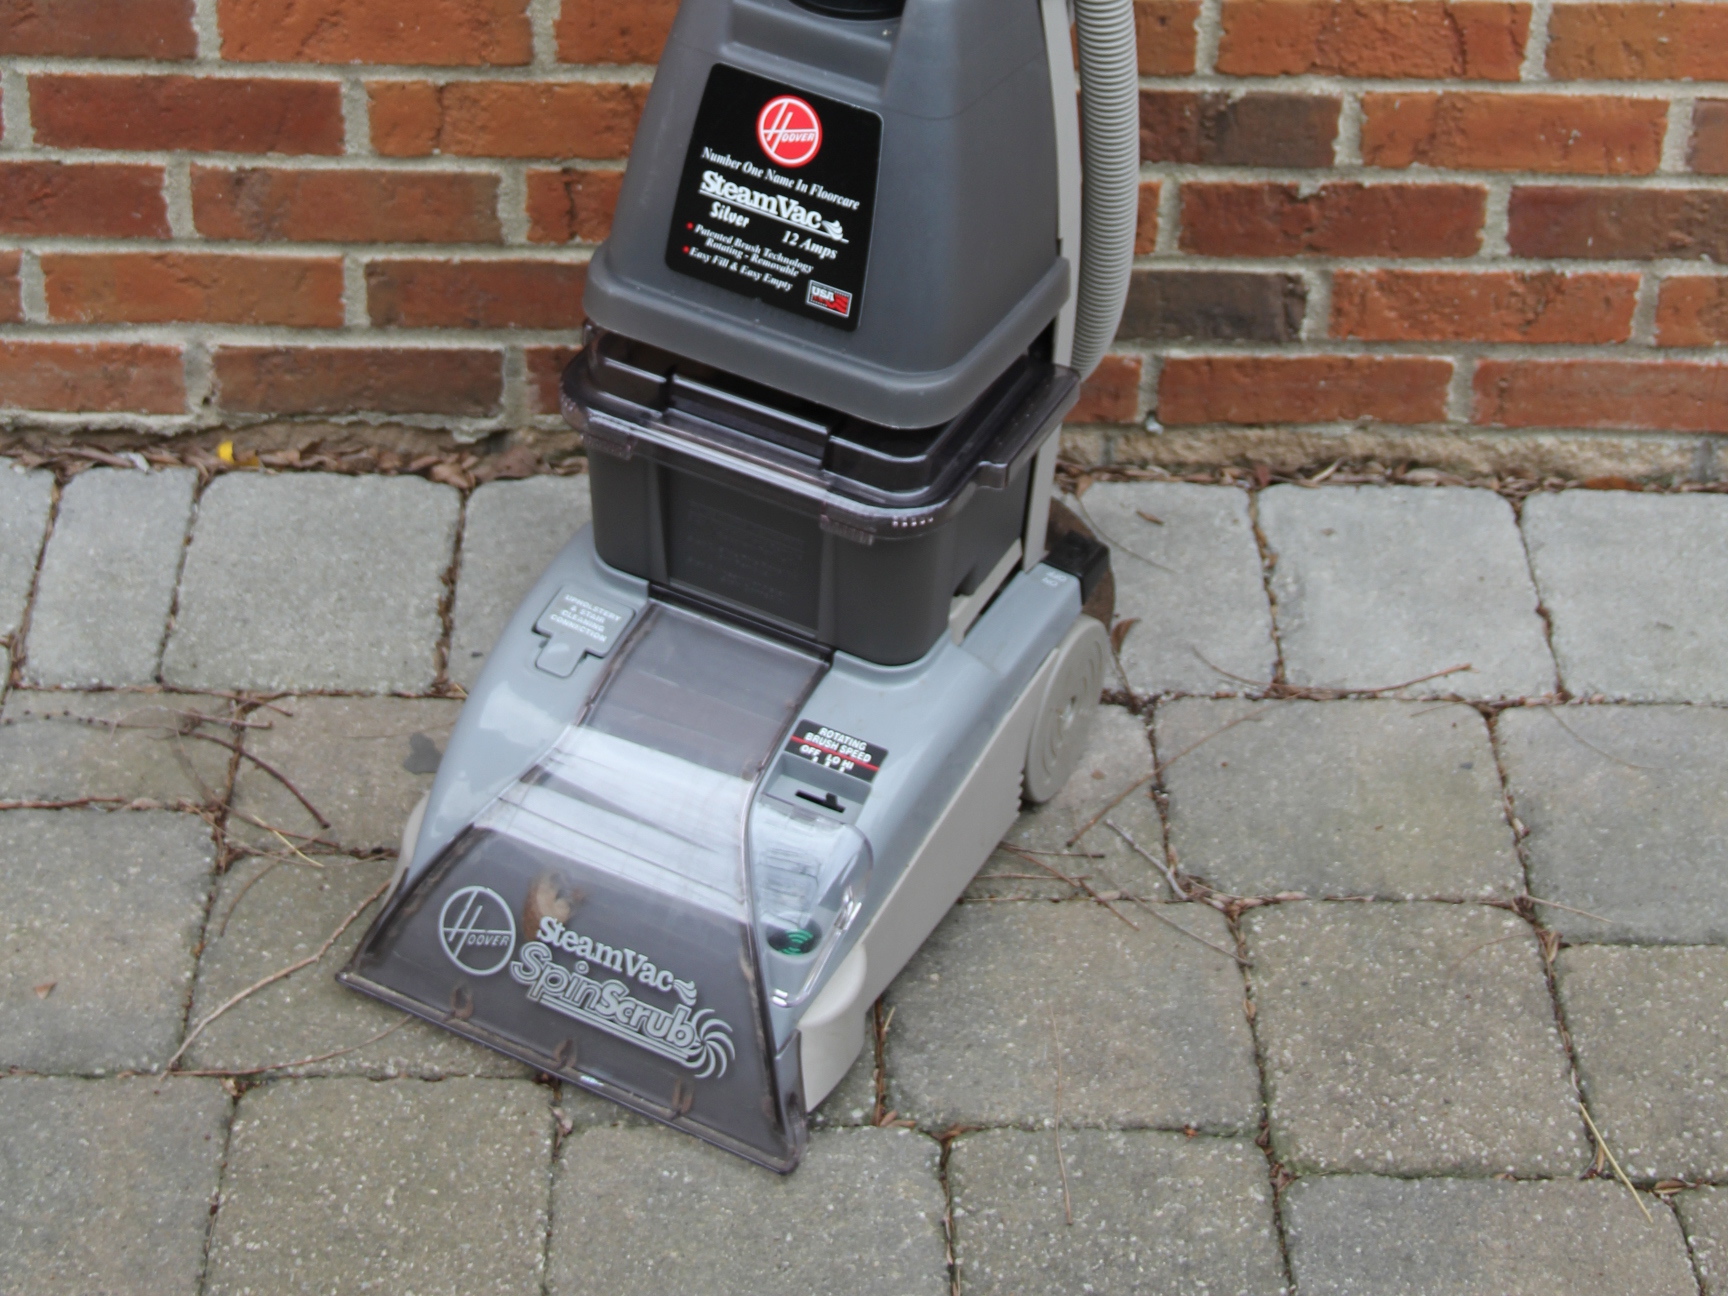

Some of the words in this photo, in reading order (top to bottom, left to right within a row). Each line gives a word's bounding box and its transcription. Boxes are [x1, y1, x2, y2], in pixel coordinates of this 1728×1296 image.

[763, 101, 817, 154] HOOVER
[701, 146, 742, 170] Number
[742, 161, 764, 178] One
[765, 168, 795, 189] Name
[795, 179, 808, 193] In
[809, 183, 860, 211] Floorcare
[700, 170, 823, 229] SteamVac
[709, 201, 750, 228] Silver
[694, 223, 733, 245] Patented
[733, 236, 761, 254] Brush
[762, 247, 814, 274] Technology
[705, 237, 744, 260] Rotating
[750, 253, 799, 278] Removable
[781, 230, 800, 246] 12
[799, 238, 838, 260] Amps
[689, 246, 711, 263] Easy
[711, 254, 728, 268] Fill
[728, 261, 738, 272] &
[739, 264, 762, 282] Easy
[762, 272, 794, 292] Empty
[811, 285, 835, 303] USA
[561, 609, 605, 633] CLEANING
[564, 594, 622, 622] UPHOLSTERY
[579, 608, 606, 624] STAIR
[799, 744, 822, 756] OFF
[826, 754, 841, 765] LO
[841, 759, 854, 770] HI
[805, 732, 839, 750] BRUSH
[839, 745, 872, 763] SPEED
[819, 727, 868, 751] ROTATING
[443, 889, 513, 959] HOOVER
[536, 915, 675, 992] SteamVac
[510, 940, 700, 1050] SpinScrub
